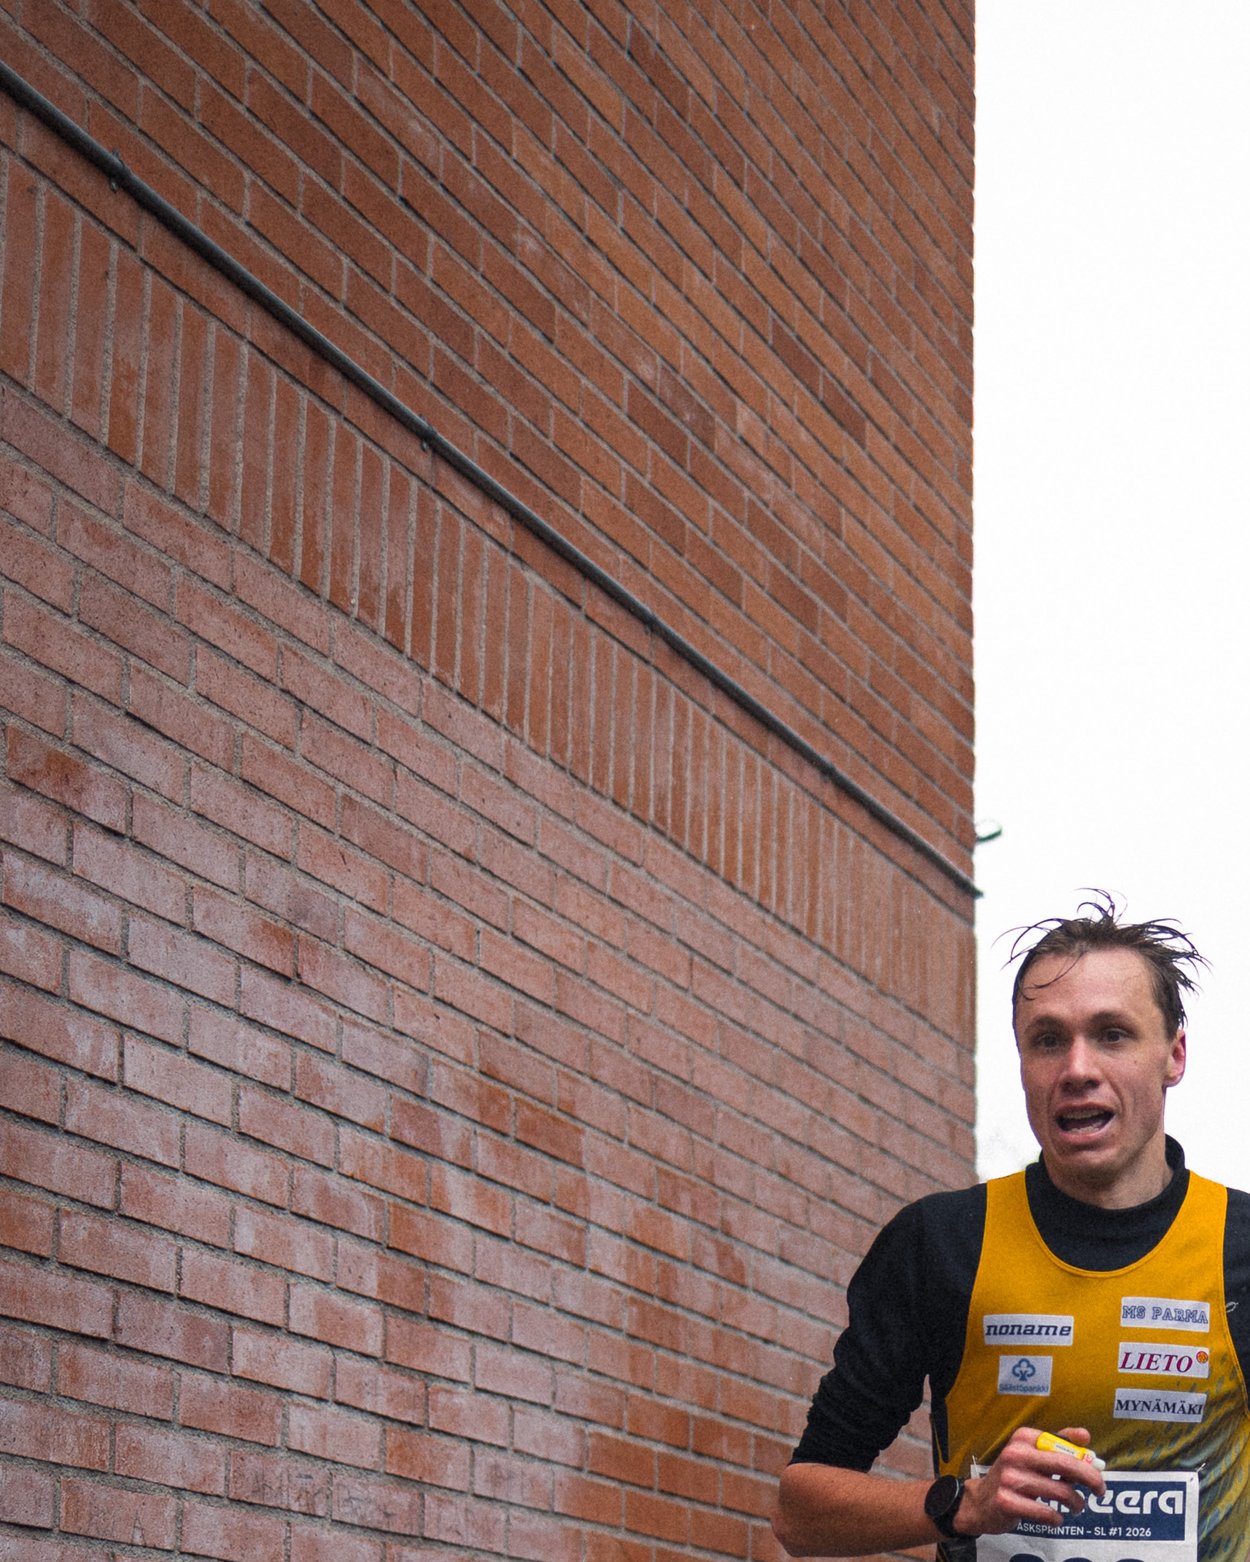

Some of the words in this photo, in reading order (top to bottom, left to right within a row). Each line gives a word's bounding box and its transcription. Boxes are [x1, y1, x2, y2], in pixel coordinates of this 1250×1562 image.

[1122, 1306, 1146, 1319] MS
[1152, 1307, 1208, 1324] PARMA
[985, 1324, 1072, 1336] noname
[1119, 1352, 1193, 1373] LIETO
[1116, 1398, 1203, 1415] MYNÄMÄKI
[1093, 1527, 1106, 1537] SL
[1109, 1527, 1122, 1537] #1
[1126, 1527, 1152, 1537] 2026
